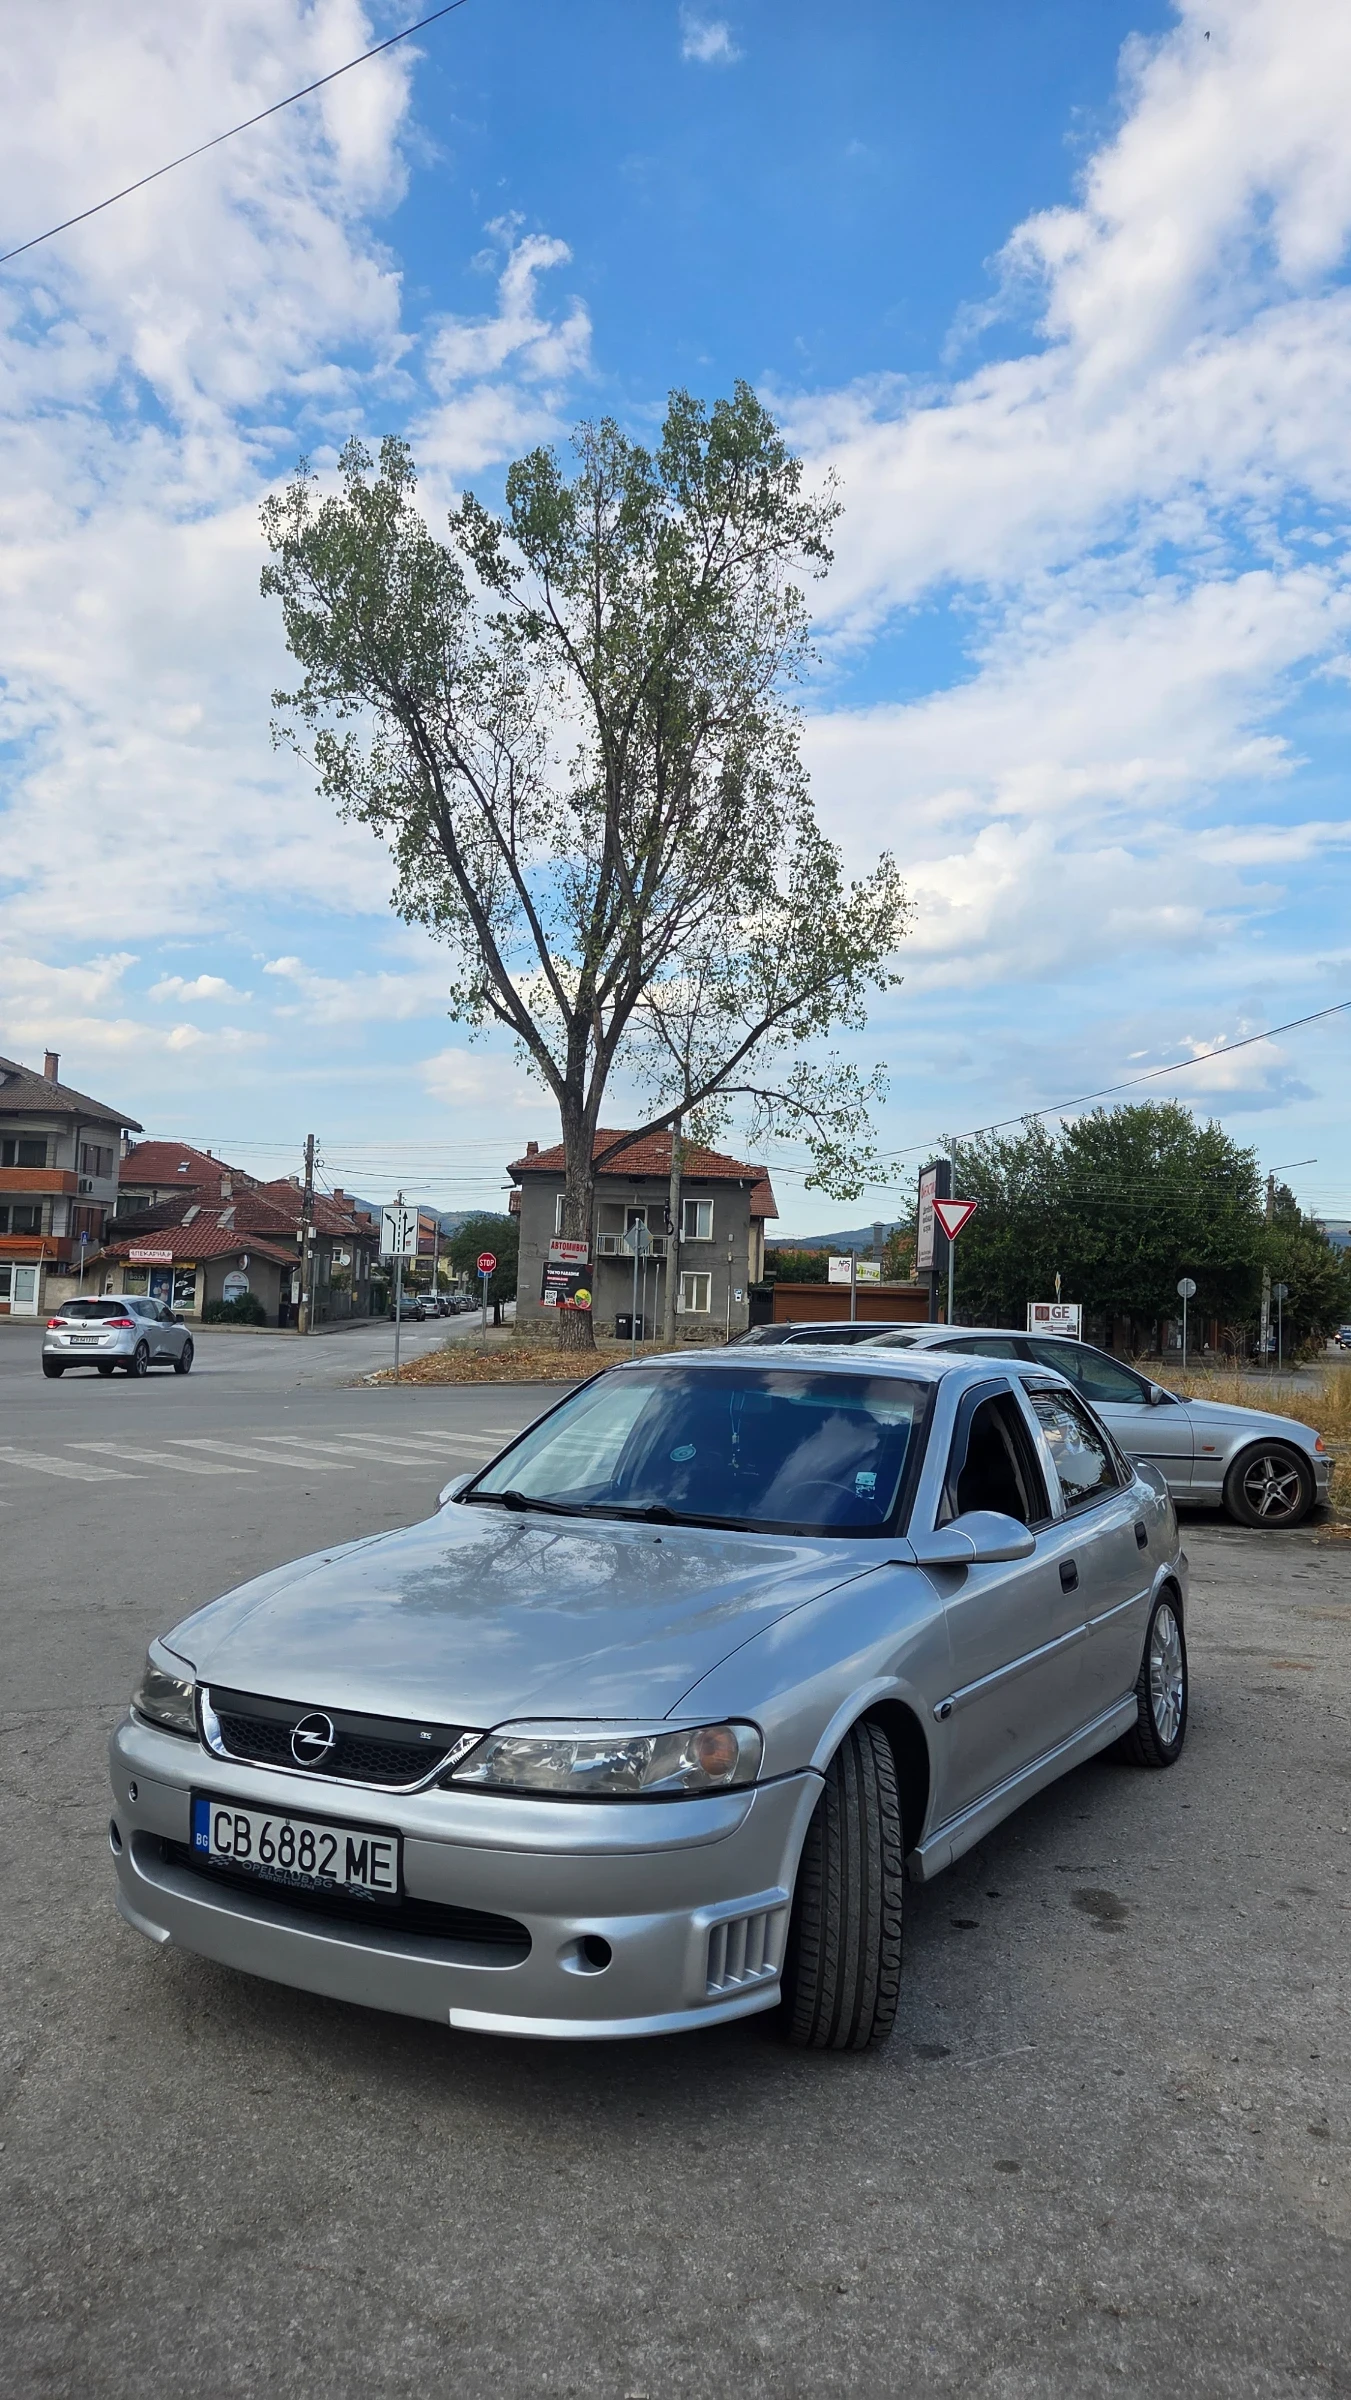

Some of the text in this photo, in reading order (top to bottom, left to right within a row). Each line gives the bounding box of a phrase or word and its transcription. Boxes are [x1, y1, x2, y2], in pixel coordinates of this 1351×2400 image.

[551, 1241, 587, 1253] АВТОМИВКА
[479, 1259, 495, 1267] STOP
[1051, 1306, 1070, 1319] GE
[195, 1832, 209, 1847] BG
[214, 1810, 393, 1889] CB 6882 ME
[242, 1860, 334, 1888] OPELCLUB.BG
